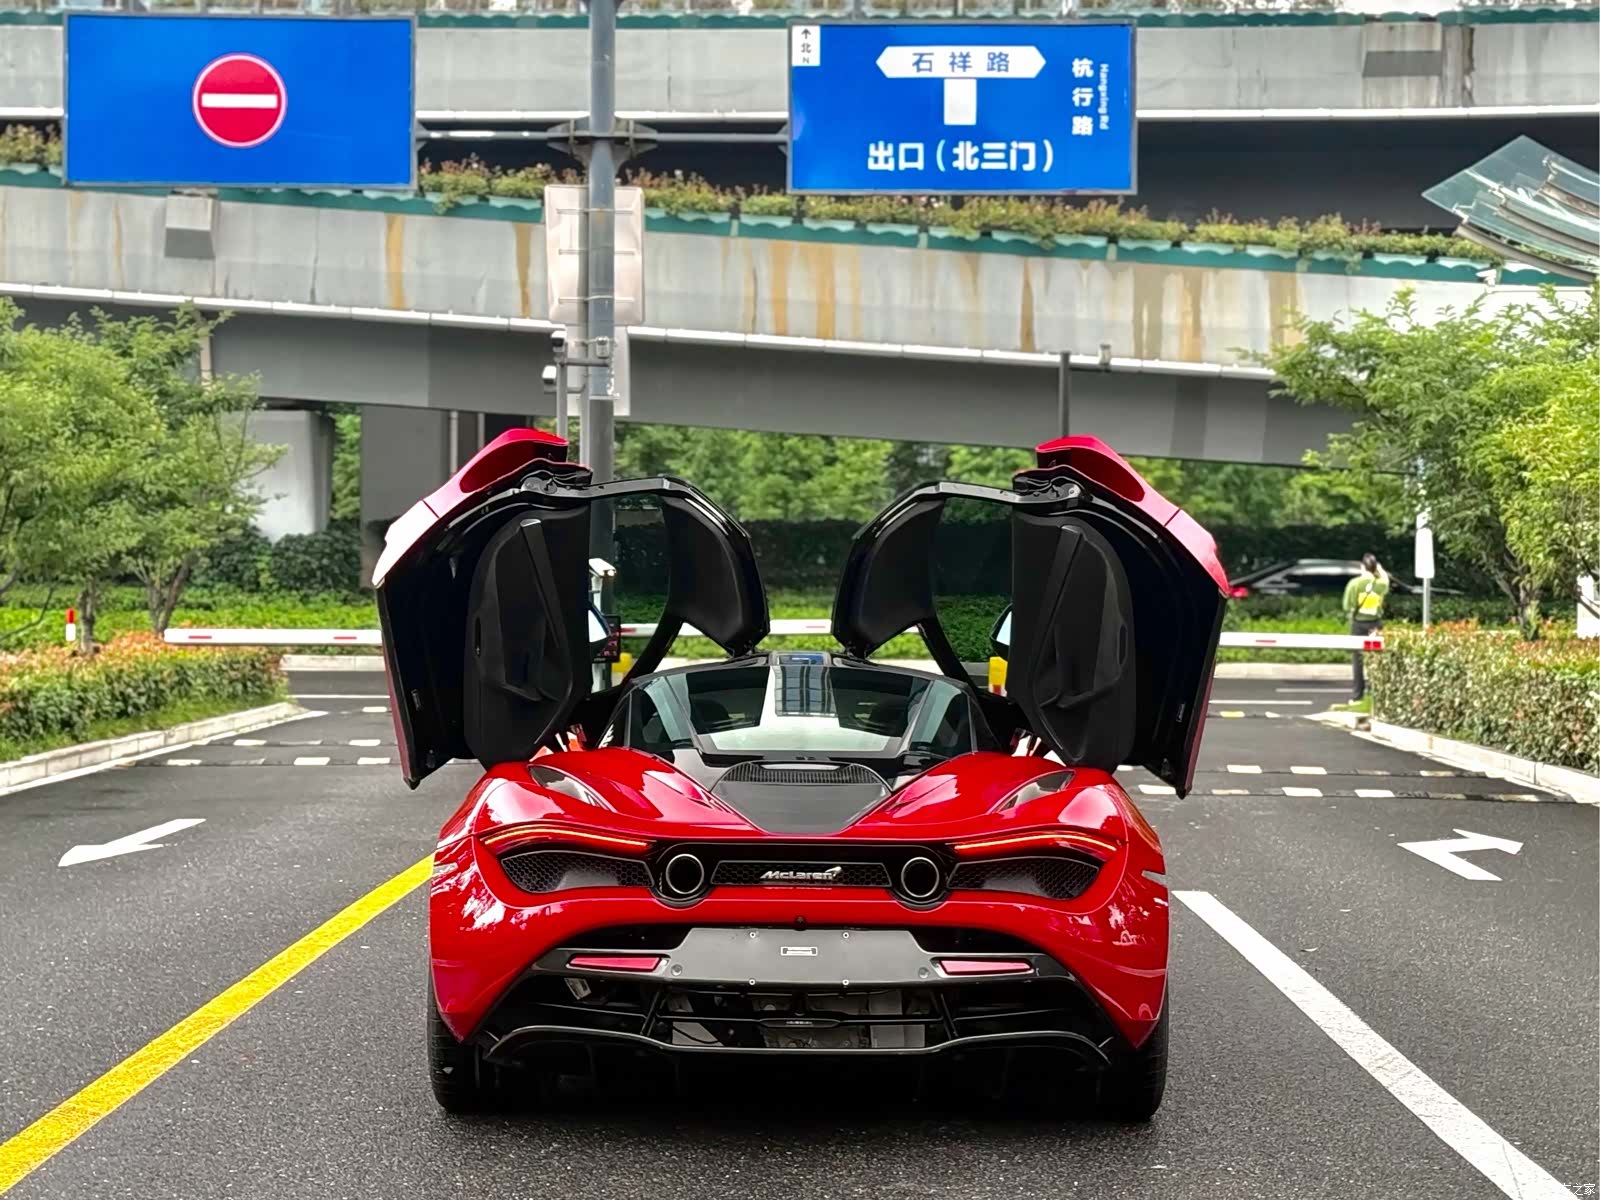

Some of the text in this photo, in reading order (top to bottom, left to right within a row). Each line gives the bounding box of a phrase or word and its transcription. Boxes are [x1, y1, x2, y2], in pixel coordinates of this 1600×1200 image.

[801, 42, 811, 54] 北
[802, 56, 810, 64] N
[912, 52, 1010, 73] 石祥路
[1072, 58, 1094, 135] 杭行路
[1097, 64, 1110, 130] Hangxing Rd
[760, 867, 837, 880] McLaren
